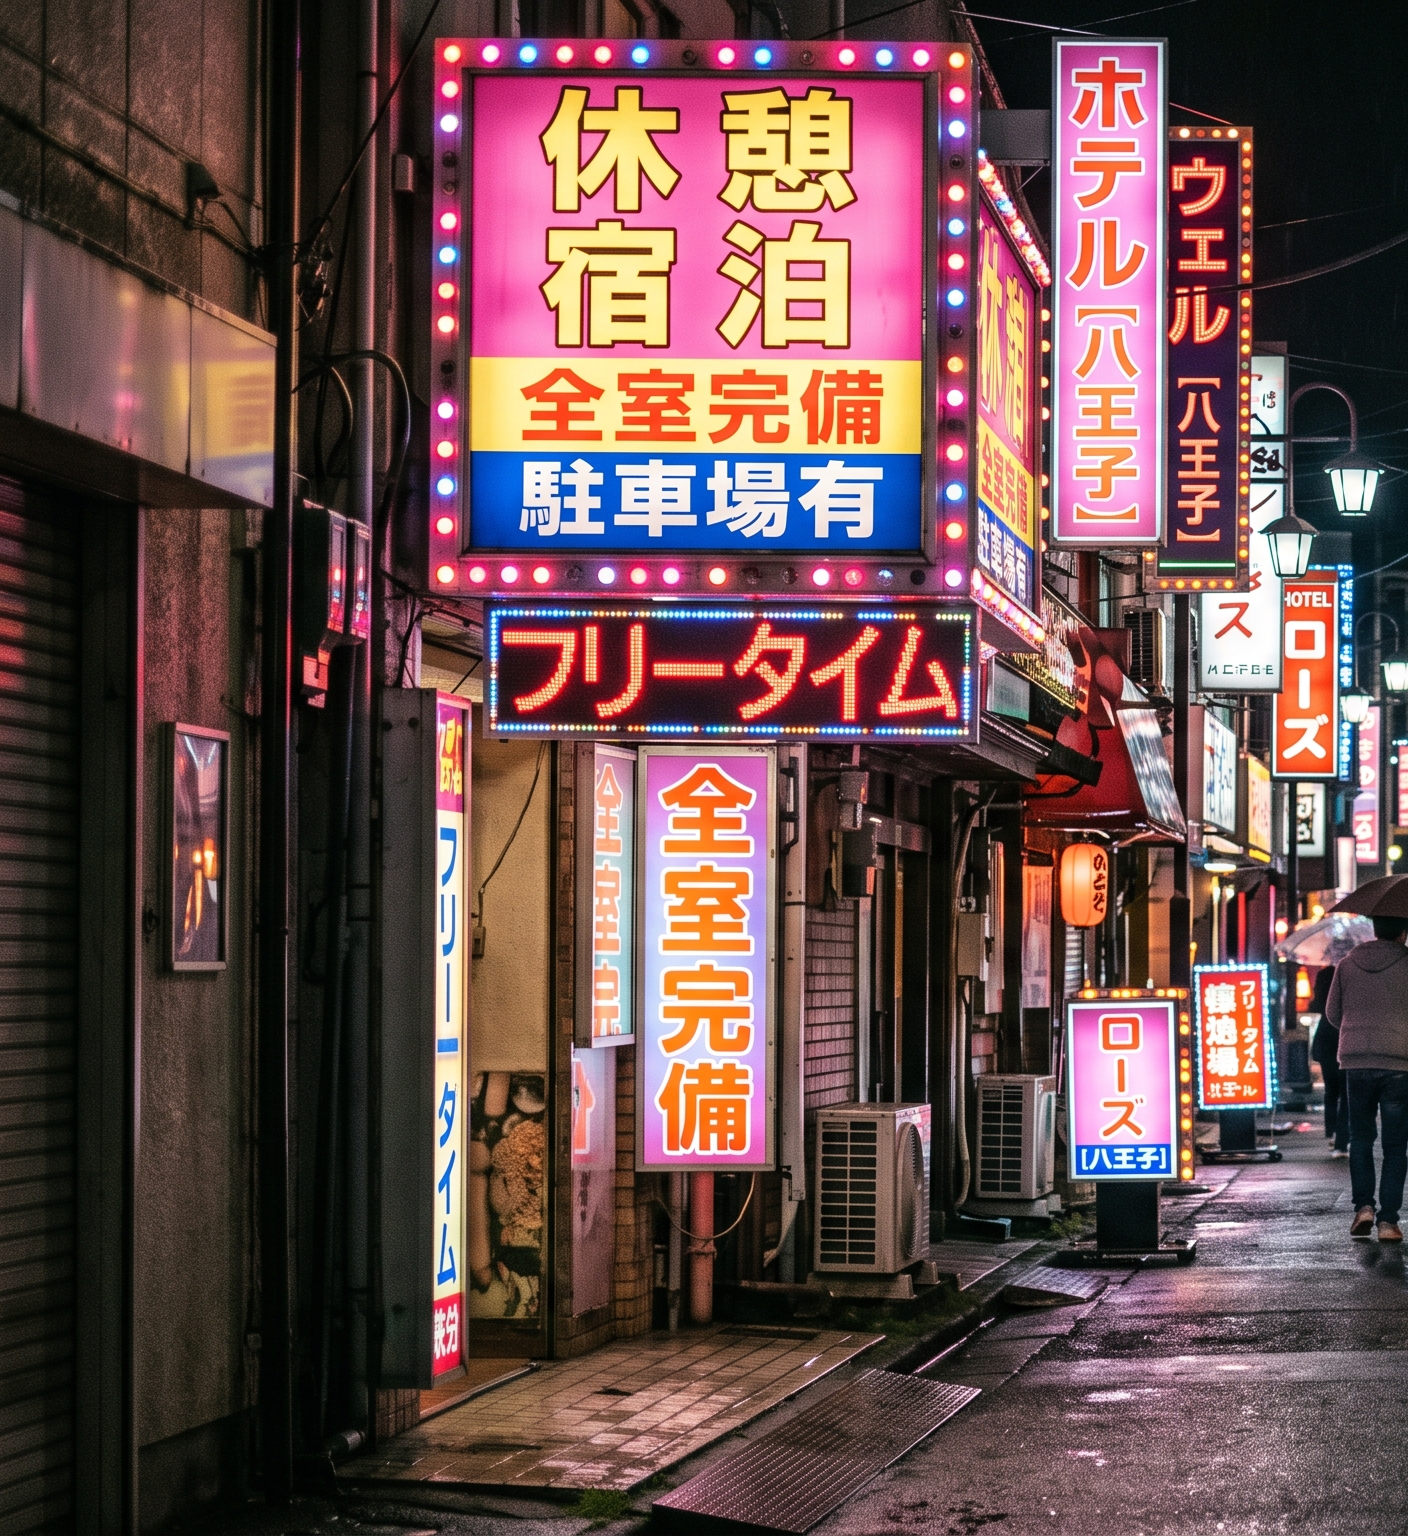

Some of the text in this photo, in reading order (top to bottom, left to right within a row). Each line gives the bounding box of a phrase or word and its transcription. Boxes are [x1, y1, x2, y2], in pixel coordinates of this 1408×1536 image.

[539, 86, 857, 213] 休憩
[539, 220, 852, 349] 宿泊
[520, 368, 884, 446] 全室完備
[519, 459, 884, 540] 駐車場有
[502, 623, 956, 722] フリータイム
[1282, 620, 1328, 759] ローズ
[656, 764, 756, 1157] 全室完備
[1100, 1014, 1145, 1138] ローズ
[1239, 980, 1260, 1074] フリータイム
